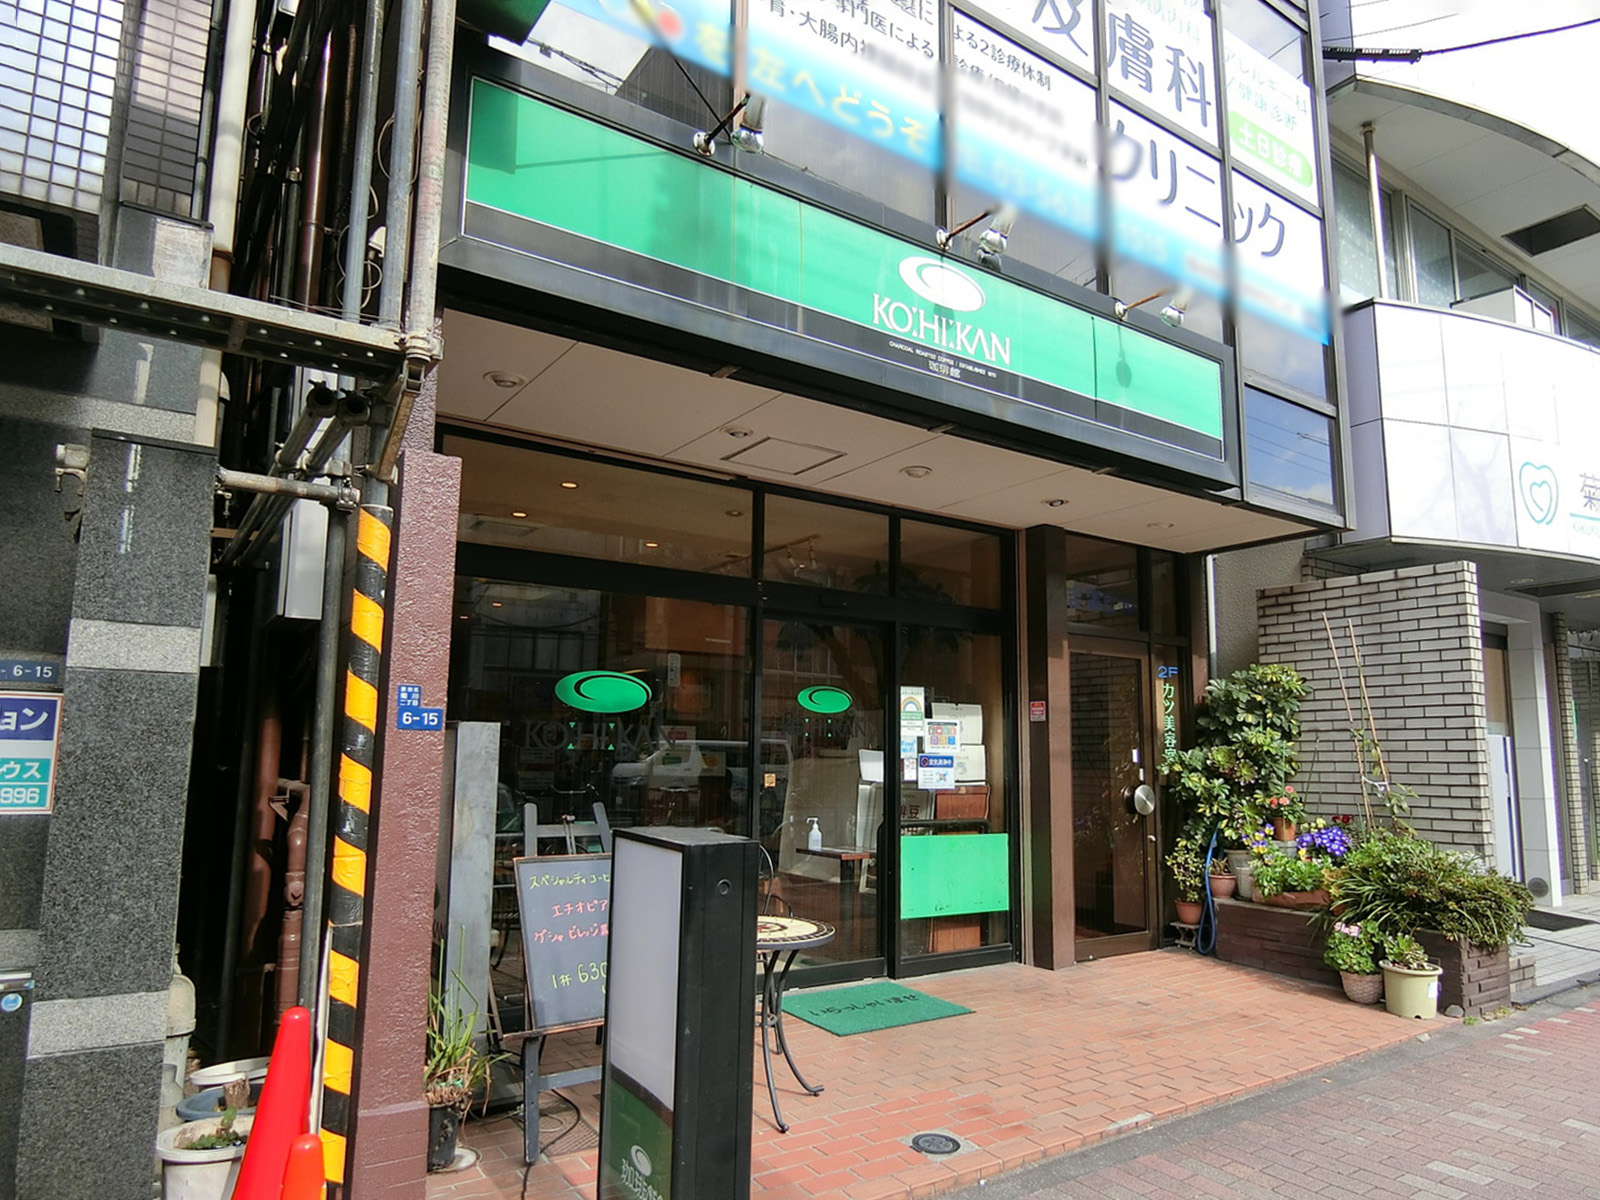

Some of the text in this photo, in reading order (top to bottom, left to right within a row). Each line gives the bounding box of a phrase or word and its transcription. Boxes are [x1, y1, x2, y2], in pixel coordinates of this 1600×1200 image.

[1107, 119, 1286, 258] クリニック
[1157, 665, 1178, 679] 2F
[402, 711, 439, 726] 6-15
[0, 761, 42, 779] ウス
[552, 899, 608, 918] エチオピア
